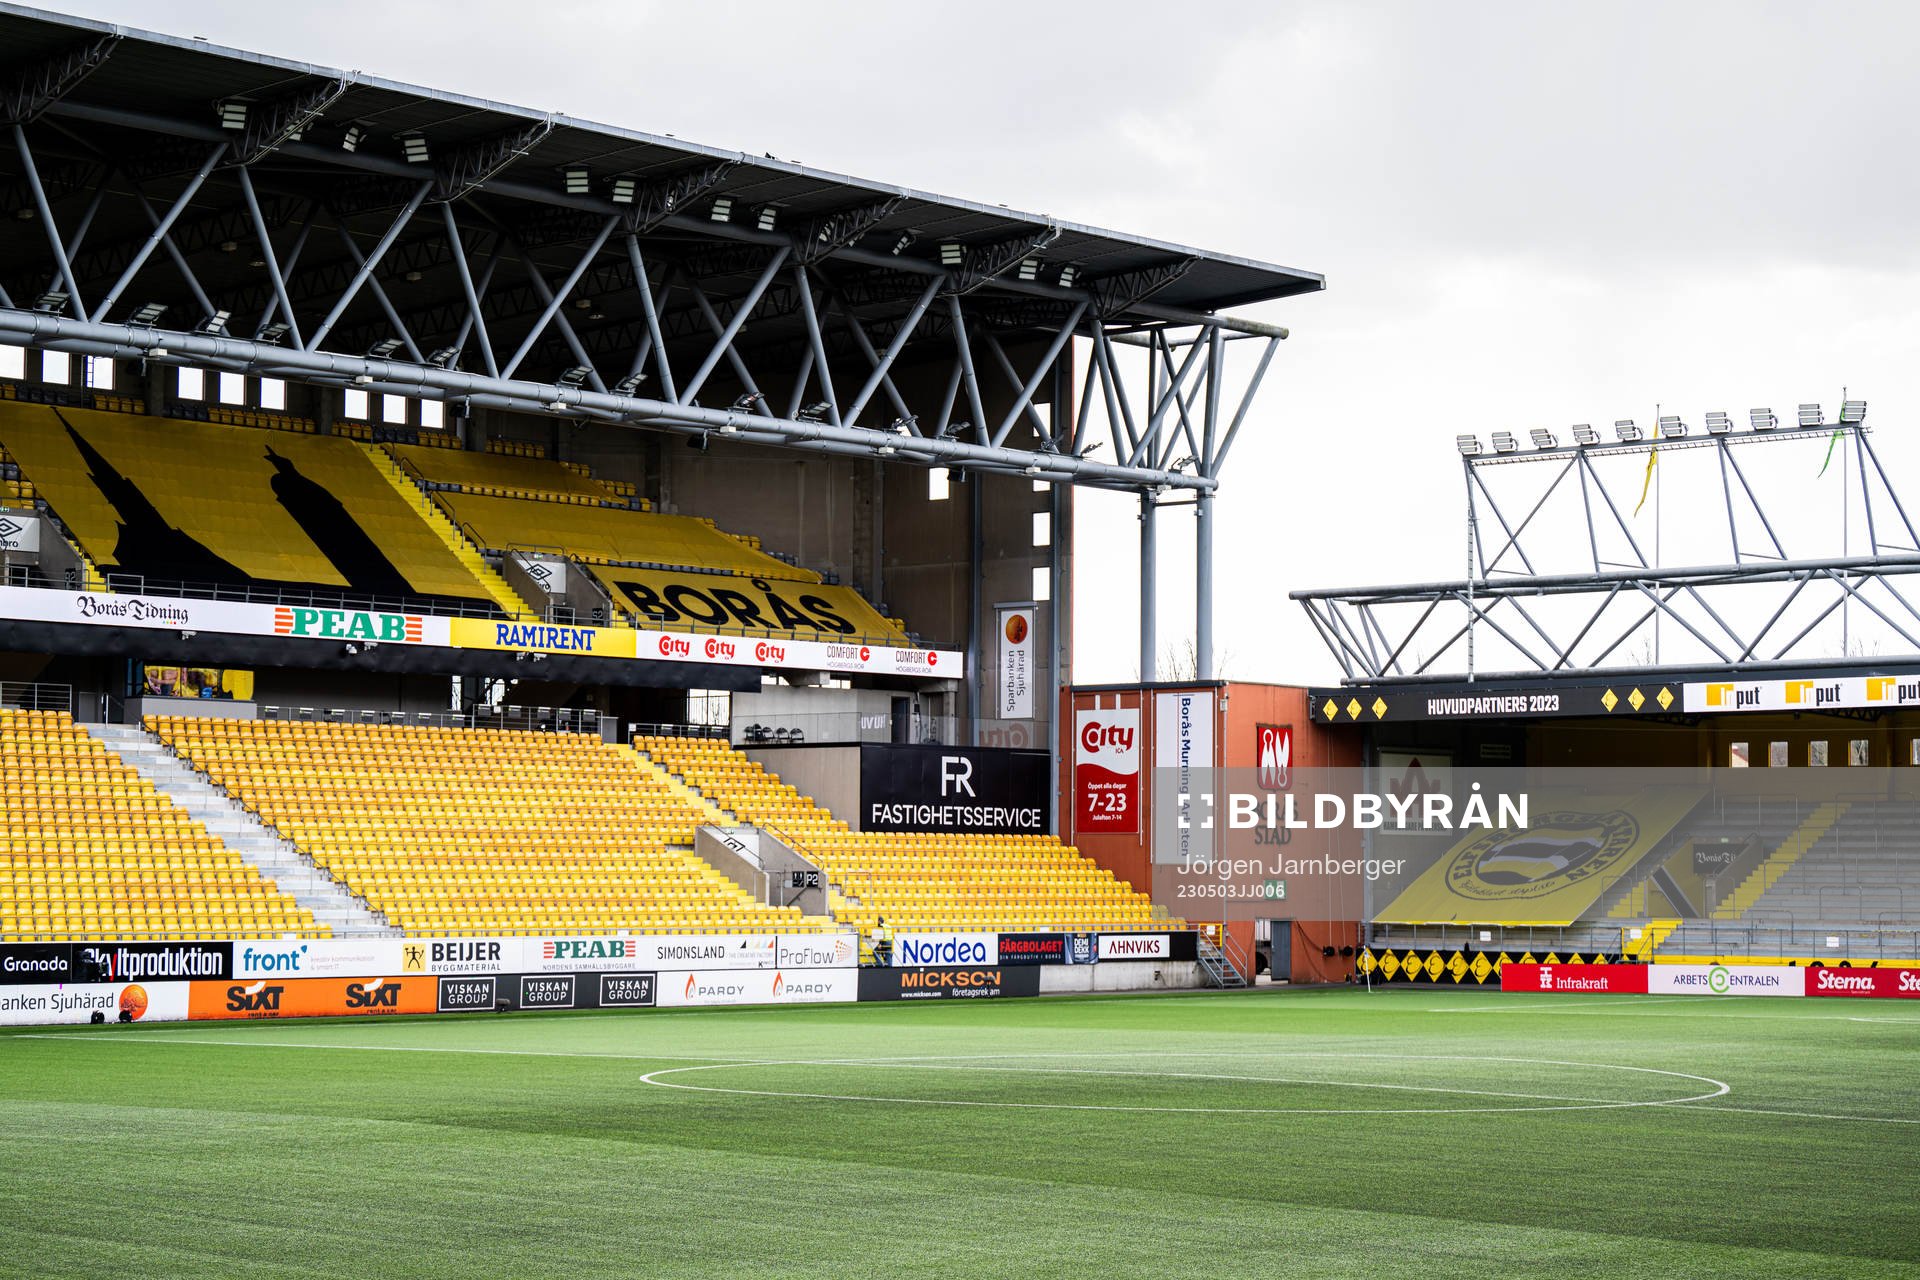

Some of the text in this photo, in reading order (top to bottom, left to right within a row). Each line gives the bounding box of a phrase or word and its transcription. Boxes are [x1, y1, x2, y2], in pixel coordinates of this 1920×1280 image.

[77, 595, 189, 625] Borås Tidning
[612, 579, 856, 635] BORÅS
[291, 607, 406, 641] PEAB
[496, 623, 596, 651] RAMIRENT
[658, 635, 690, 656] City
[704, 638, 735, 659] City
[755, 641, 785, 662] City
[827, 645, 858, 660] COMFORT
[895, 650, 926, 664] COMFORT
[1006, 650, 1015, 712] Sparbanken
[1016, 650, 1025, 696] Sjuhärad
[1427, 695, 1560, 715] HUVUDPARTNERS 2023
[1181, 697, 1192, 737] Borås
[1081, 721, 1134, 754] City
[941, 755, 976, 797] FR
[1087, 793, 1127, 812] 7-23
[872, 803, 1041, 828] FASTIGHETSSERVICE
[806, 872, 819, 886] P2
[431, 941, 501, 962] BEIJER
[553, 940, 625, 959] PEAB
[657, 945, 725, 960] SIMONSLAND
[902, 937, 986, 964] Nordea
[999, 938, 1063, 953] FÄRGBOLAGET
[4, 955, 68, 972] Granada
[243, 947, 301, 972] front
[780, 948, 835, 965] ProFlow
[431, 963, 501, 972] BYGGMATERIAL
[447, 984, 489, 994] VISKAN
[527, 981, 569, 992] VISKAN
[607, 980, 649, 991] VISKAN
[699, 985, 745, 996] PAROY
[786, 984, 833, 995] PAROY
[952, 987, 1000, 998] företagsrekam
[1556, 977, 1608, 989] Infrakraft
[51, 992, 114, 1013] Sjuhärad
[448, 993, 488, 1004] GROUP
[528, 992, 567, 1002] GROUP
[608, 990, 647, 1000] GROUP
